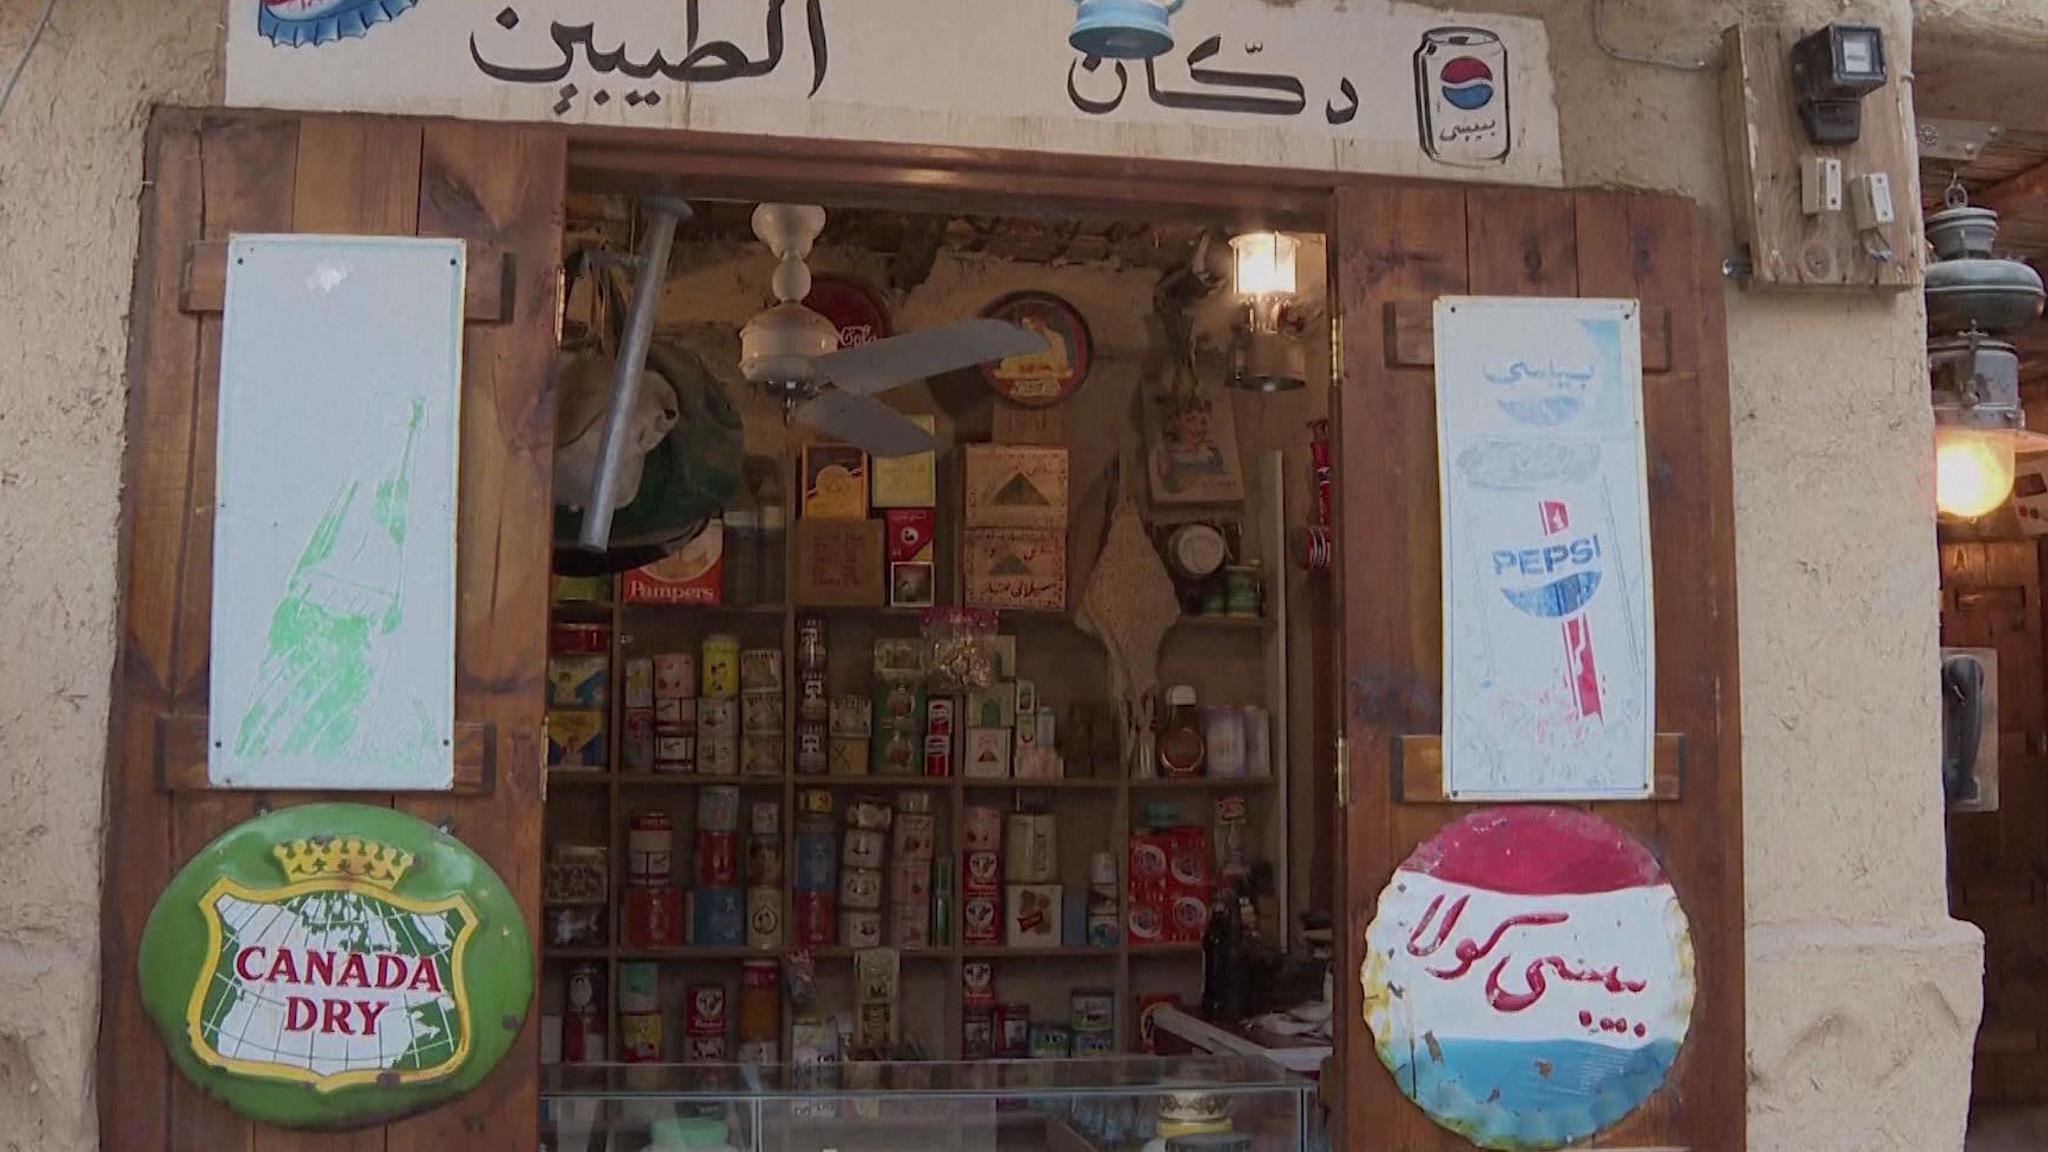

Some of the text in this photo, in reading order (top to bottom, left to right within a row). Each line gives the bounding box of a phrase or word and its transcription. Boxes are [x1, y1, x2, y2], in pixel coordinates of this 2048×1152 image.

[1493, 534, 1601, 575] PEPSI
[629, 580, 714, 604] Pampers
[236, 946, 442, 992] CANADA
[285, 996, 389, 1035] DRY
